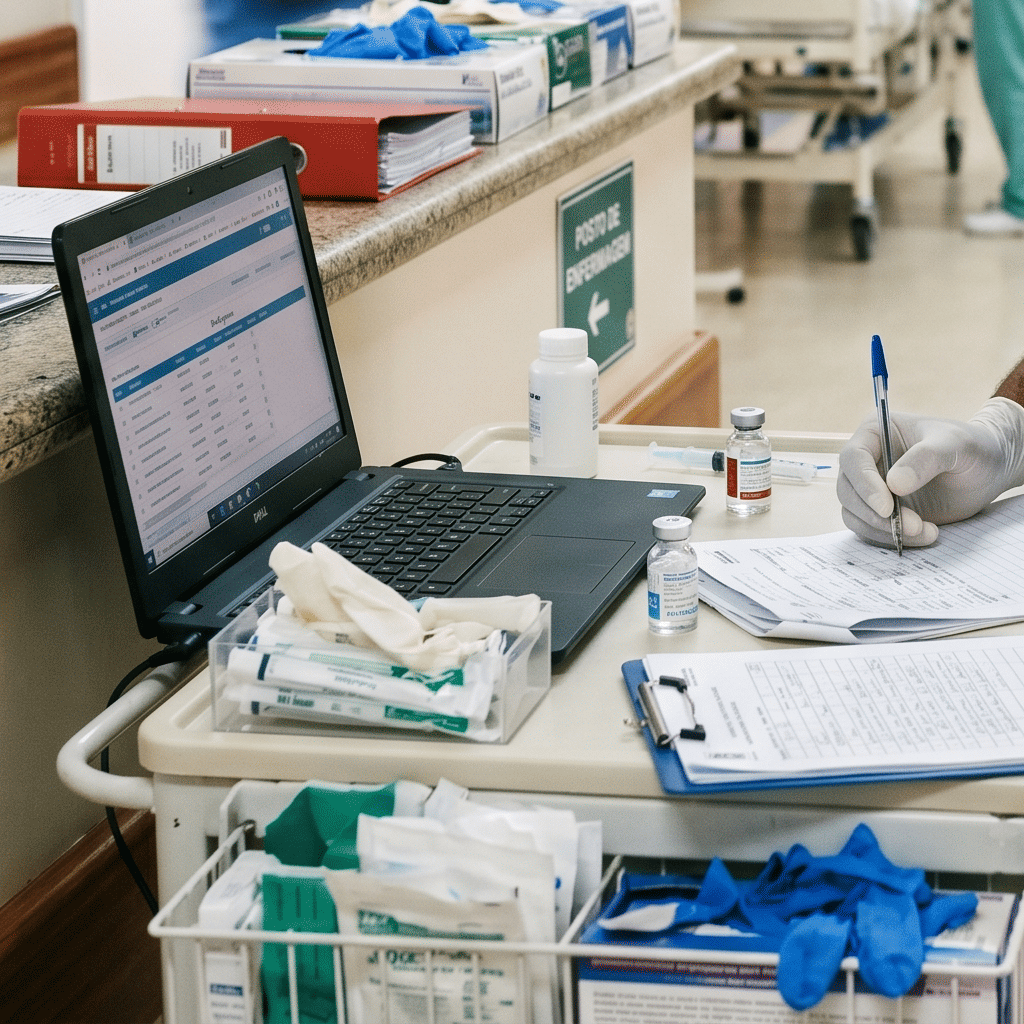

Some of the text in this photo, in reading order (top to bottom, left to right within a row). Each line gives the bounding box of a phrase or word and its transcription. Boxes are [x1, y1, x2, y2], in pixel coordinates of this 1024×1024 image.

[575, 202, 621, 251] POSTO DE
[566, 230, 631, 294] ENFERMAGEM
